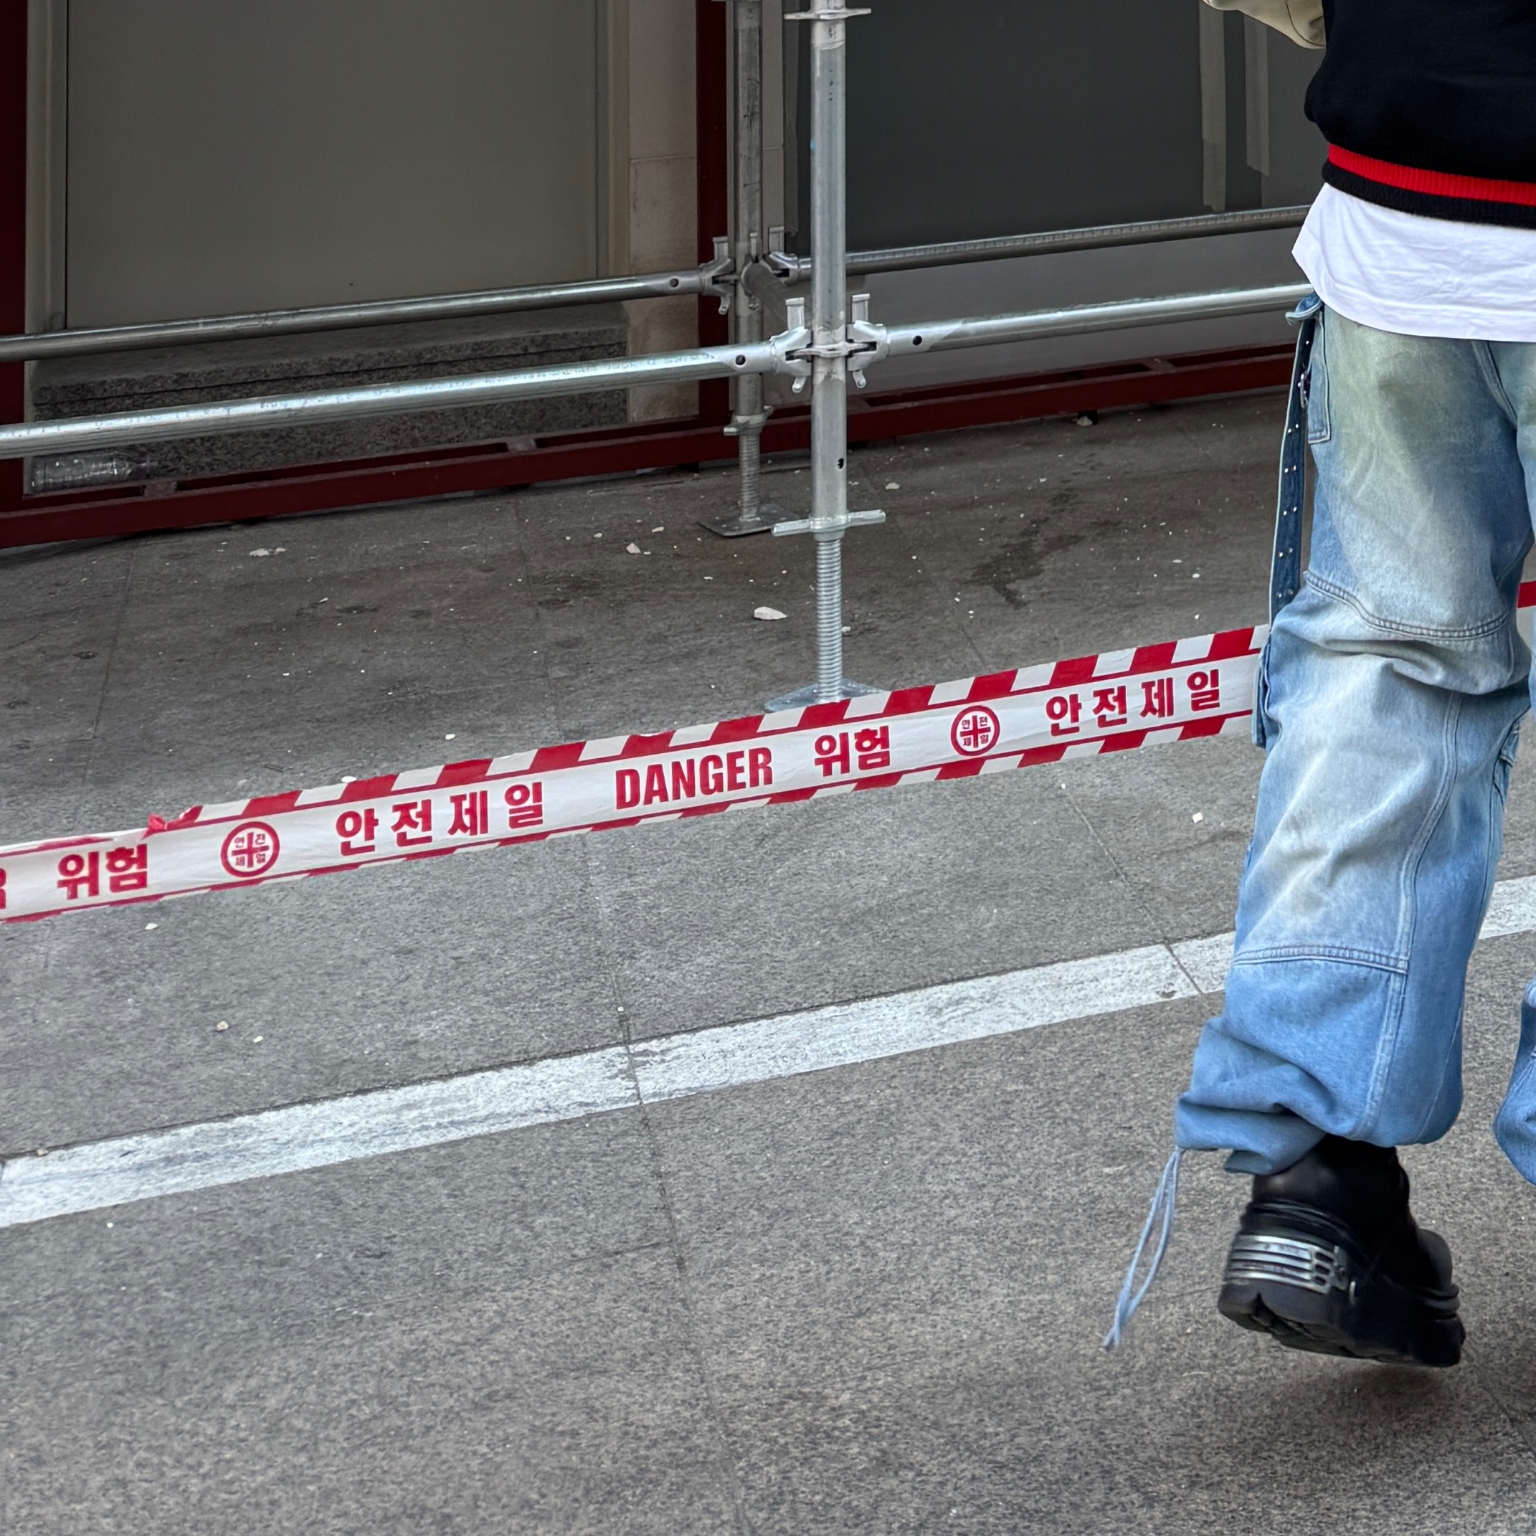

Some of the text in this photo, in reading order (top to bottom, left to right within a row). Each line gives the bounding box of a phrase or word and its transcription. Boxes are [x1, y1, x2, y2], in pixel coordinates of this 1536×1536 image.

[56, 842, 149, 902] 위험
[335, 782, 545, 857] 안전제일
[615, 746, 773, 810] DANGER
[813, 724, 891, 779] 위험
[1045, 668, 1222, 738] 안전제일
